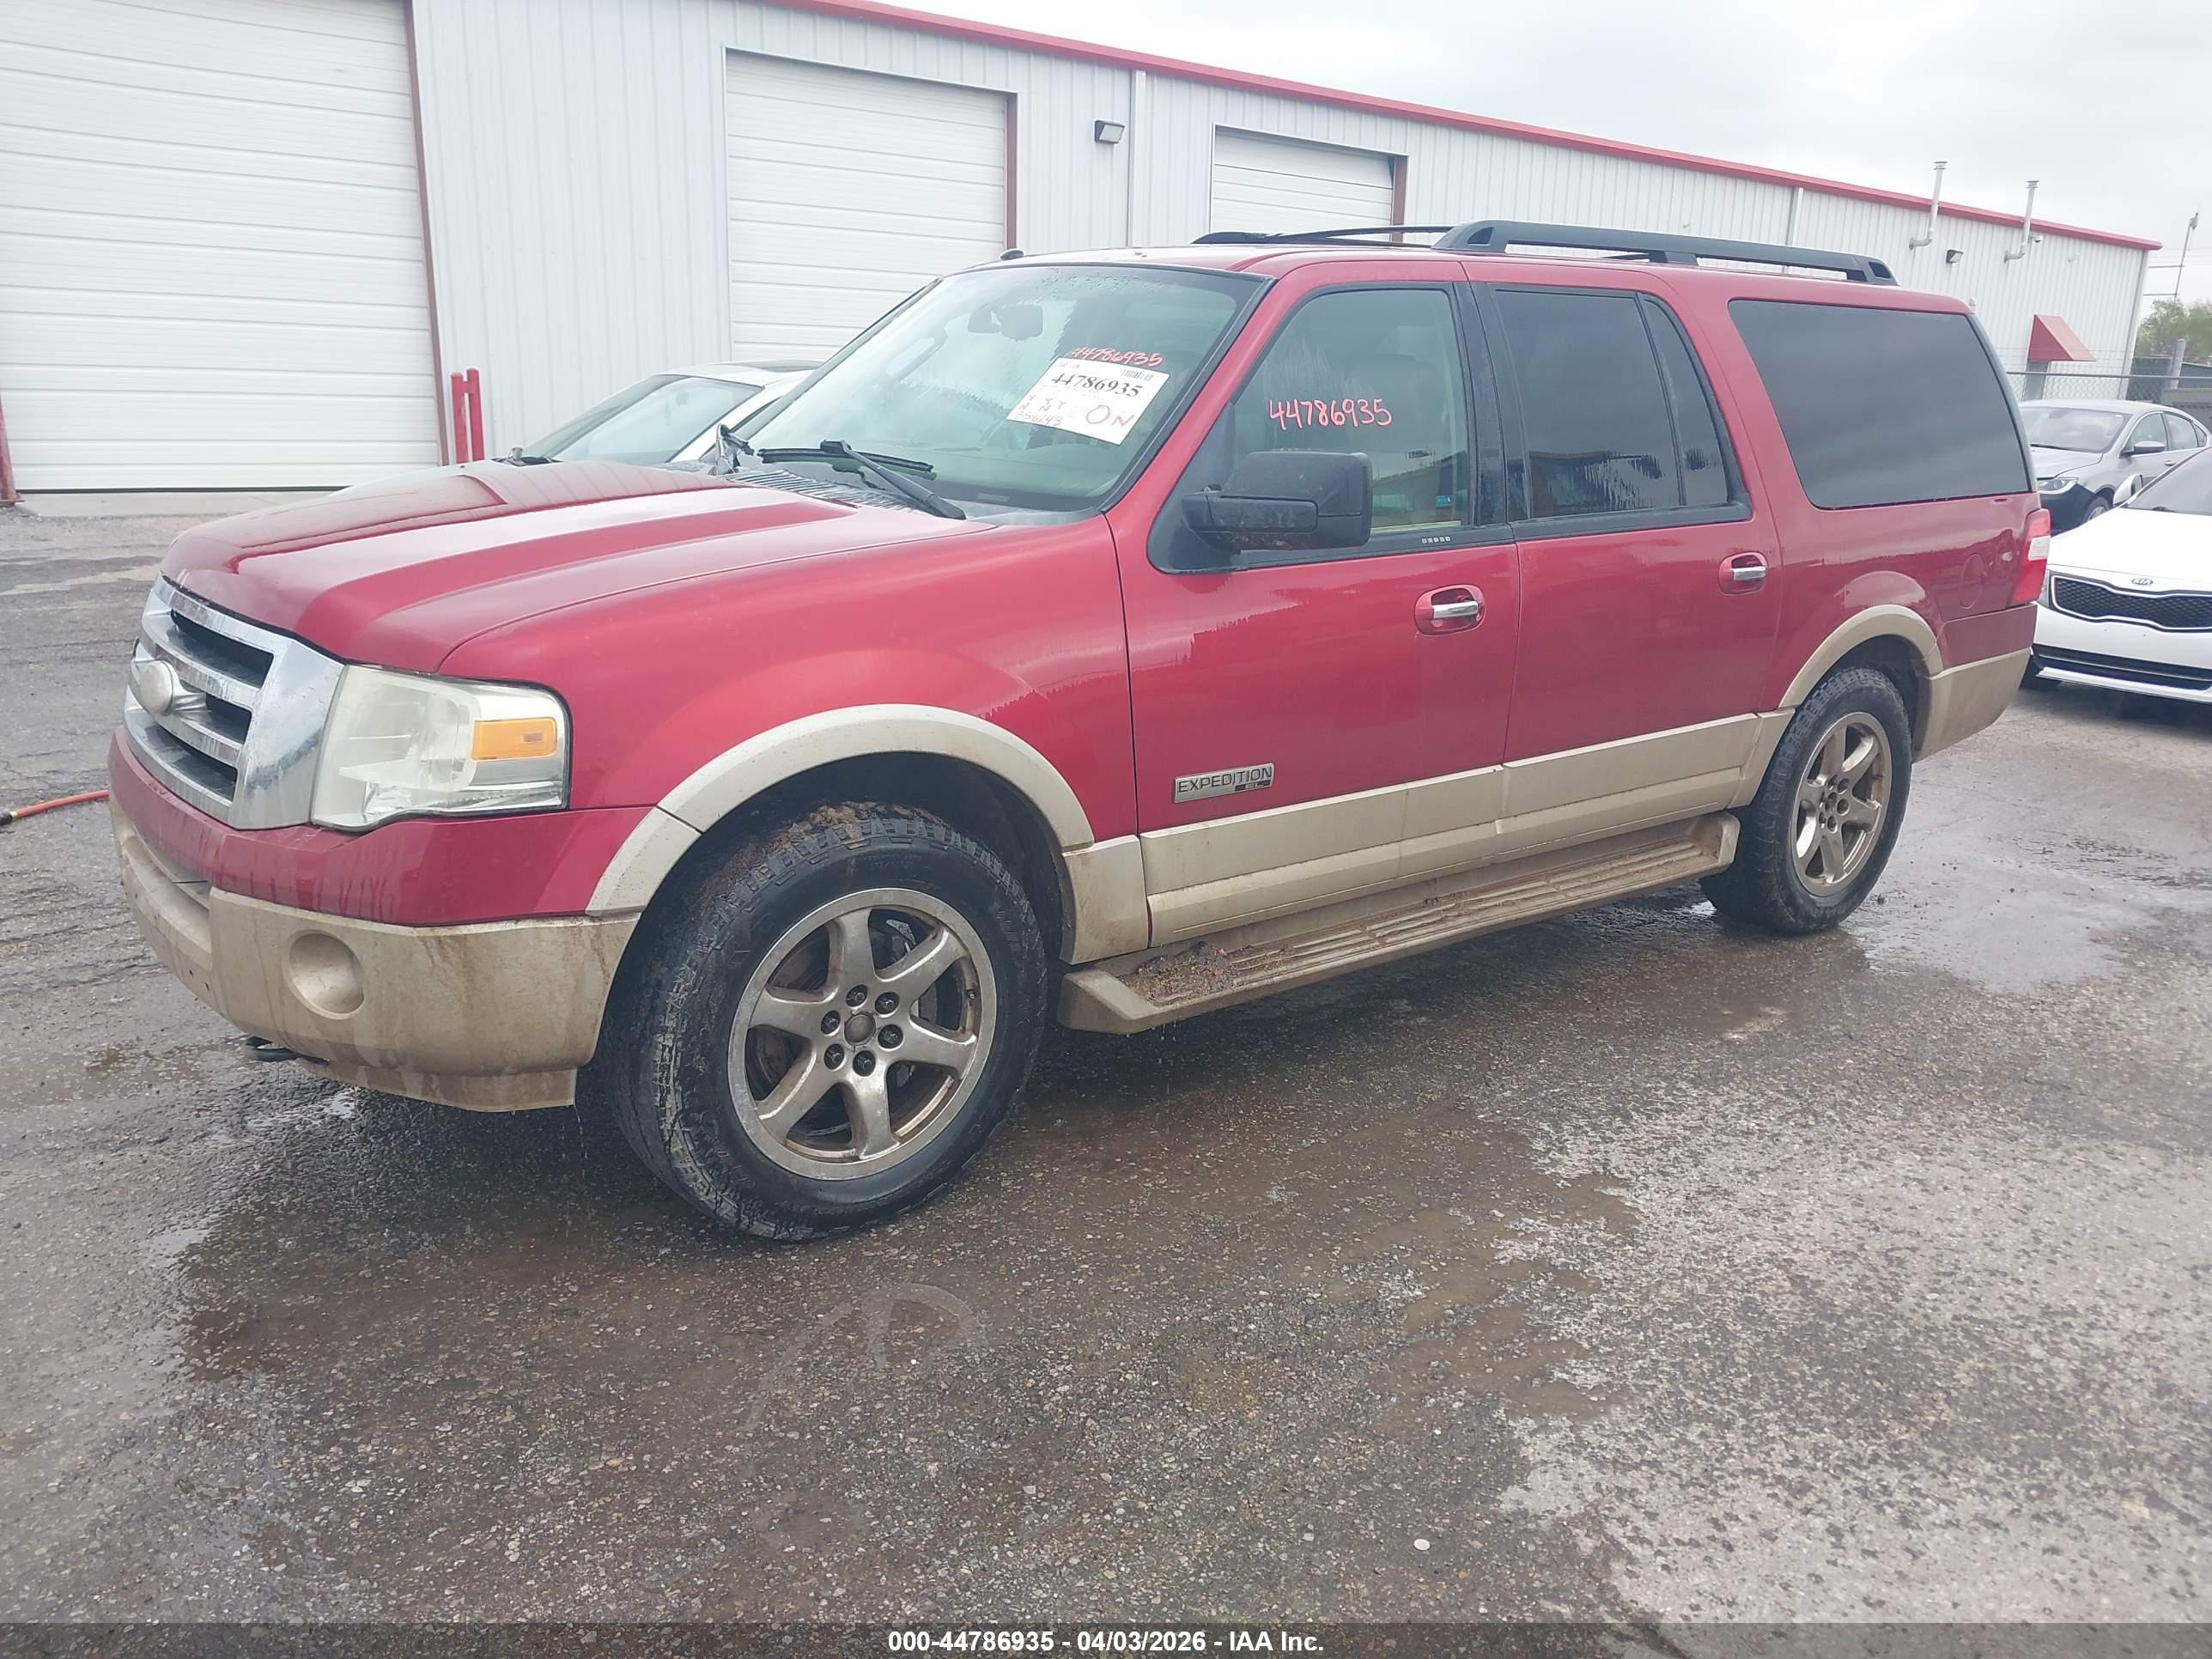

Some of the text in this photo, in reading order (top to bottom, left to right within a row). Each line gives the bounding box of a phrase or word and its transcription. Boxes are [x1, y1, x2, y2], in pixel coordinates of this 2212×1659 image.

[1072, 346, 1163, 367] 44786935
[1051, 373, 1143, 398] 44786935
[1268, 398, 1393, 430] 44786935
[1177, 766, 1273, 793] EXPEDITION
